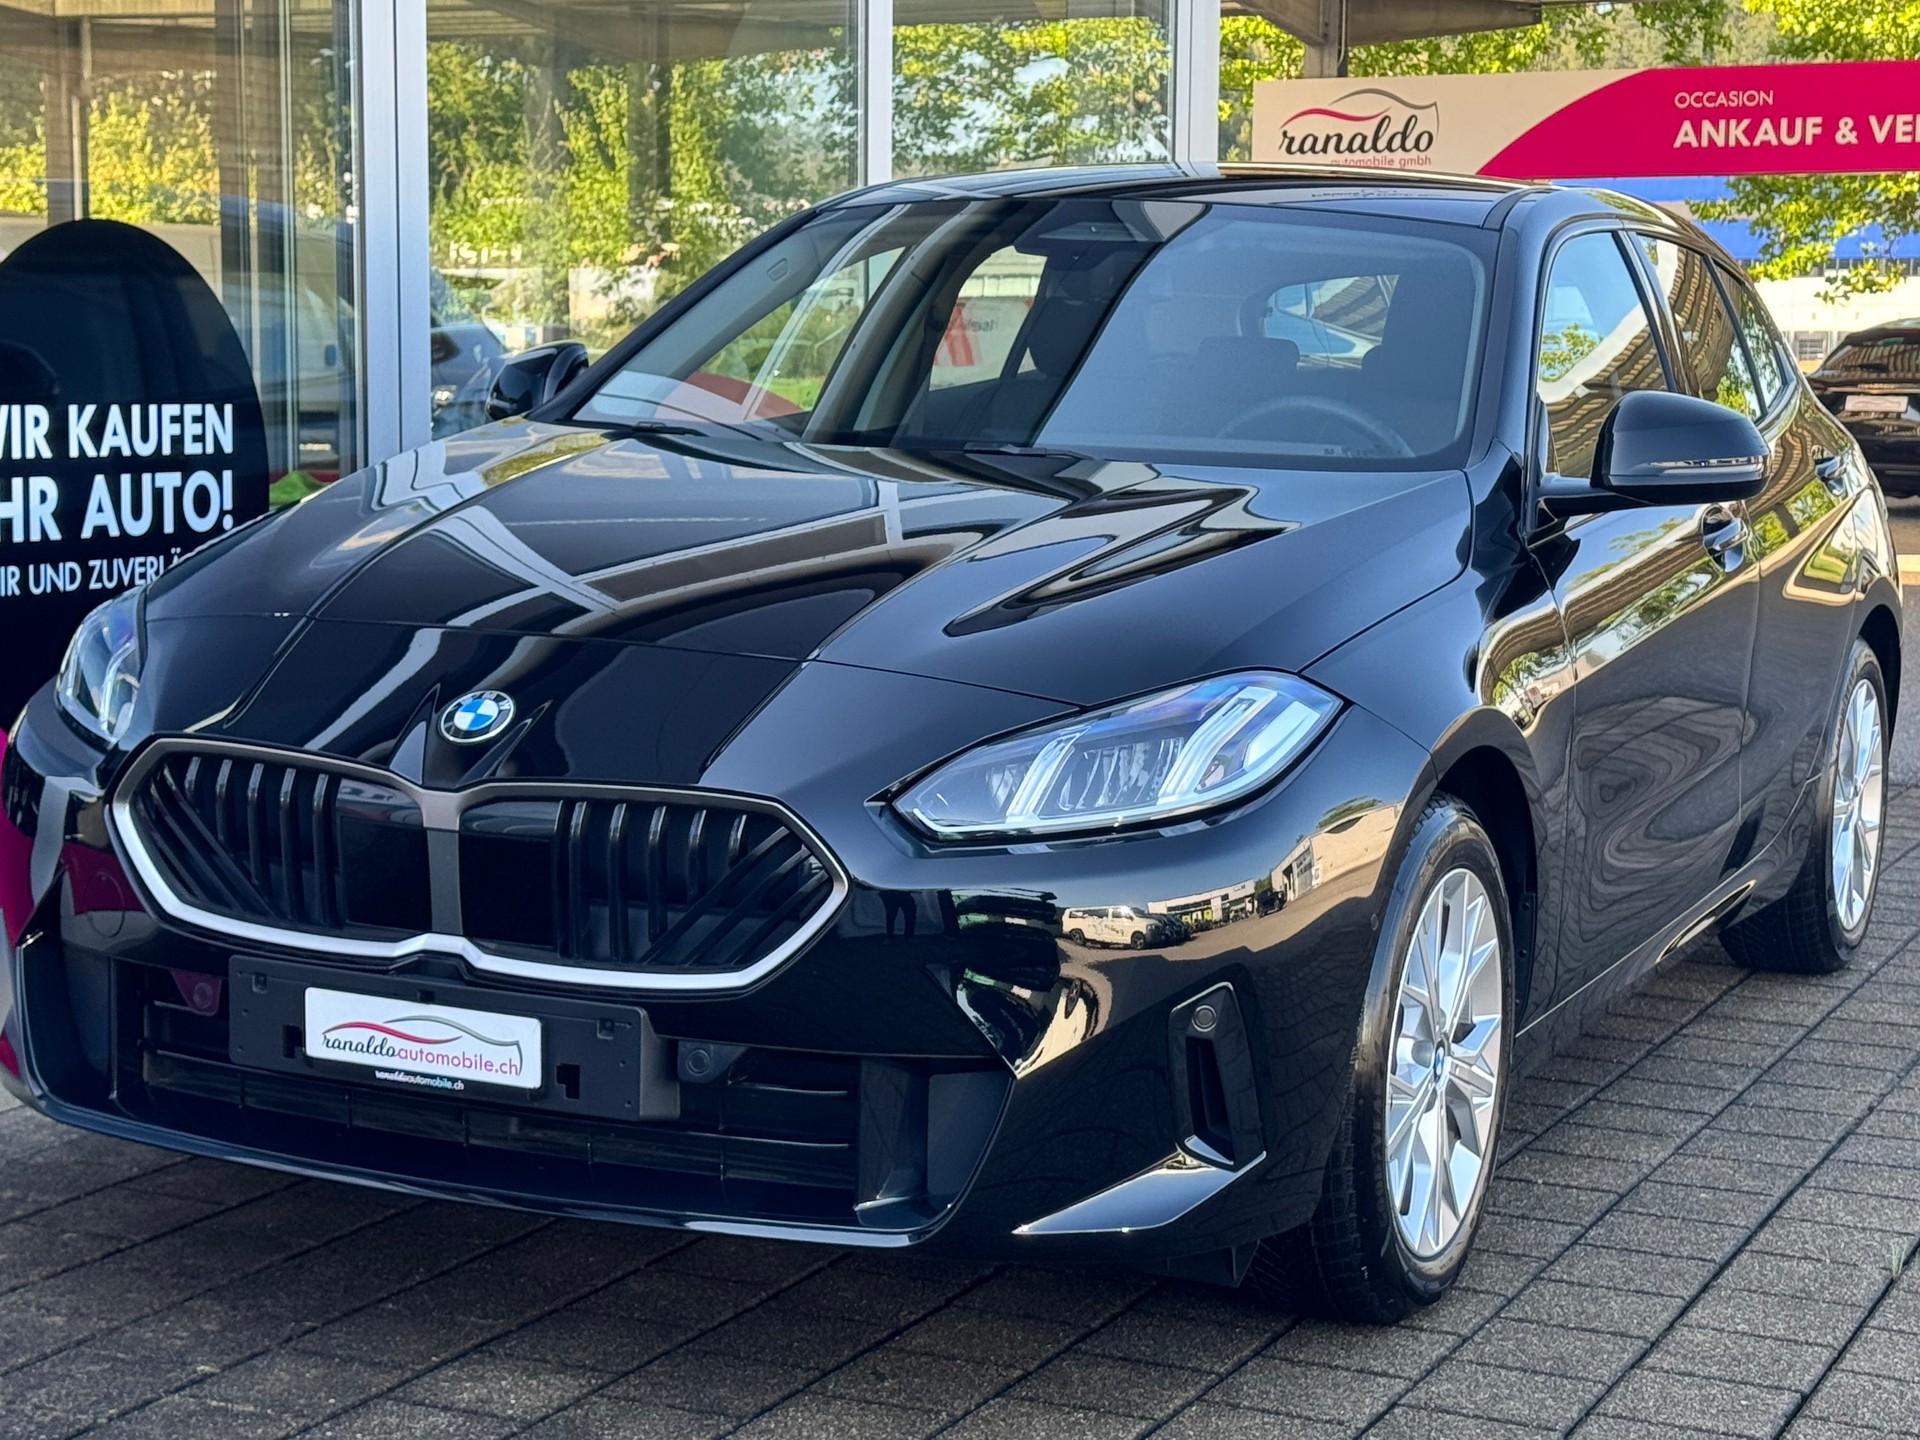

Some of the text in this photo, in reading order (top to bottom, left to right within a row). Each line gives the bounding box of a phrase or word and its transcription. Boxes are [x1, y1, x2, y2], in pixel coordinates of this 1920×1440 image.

[1674, 90, 1774, 109] OCCASION
[1278, 114, 1434, 155] ranaldo
[1673, 114, 1920, 148] ANKAUF & VE
[1398, 155, 1432, 168] gmbh
[0, 403, 233, 459] IR KAUFEN
[80, 469, 234, 539] AUTO!
[28, 561, 82, 595] UND
